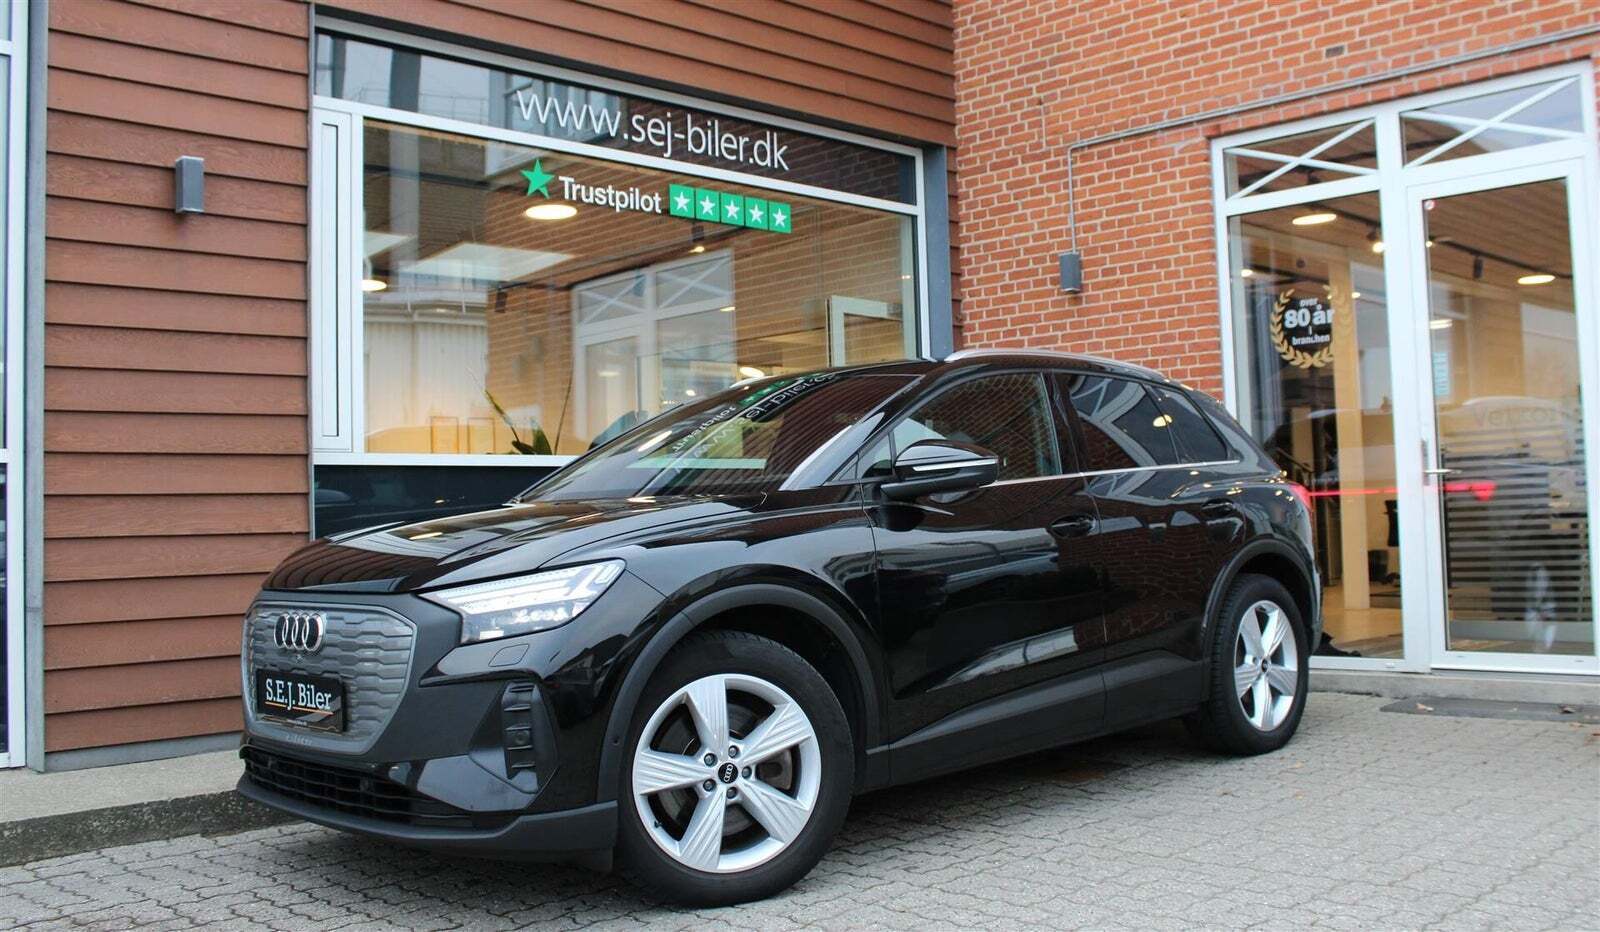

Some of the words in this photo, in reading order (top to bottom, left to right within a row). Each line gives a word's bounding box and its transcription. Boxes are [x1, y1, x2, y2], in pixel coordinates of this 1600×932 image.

[516, 89, 790, 171] www.sej-biler.dk
[558, 175, 662, 214] Trustpilot
[1284, 308, 1311, 328] 80
[1312, 304, 1335, 325] år
[265, 678, 296, 710] S.E.J.
[297, 684, 332, 710] Biler
